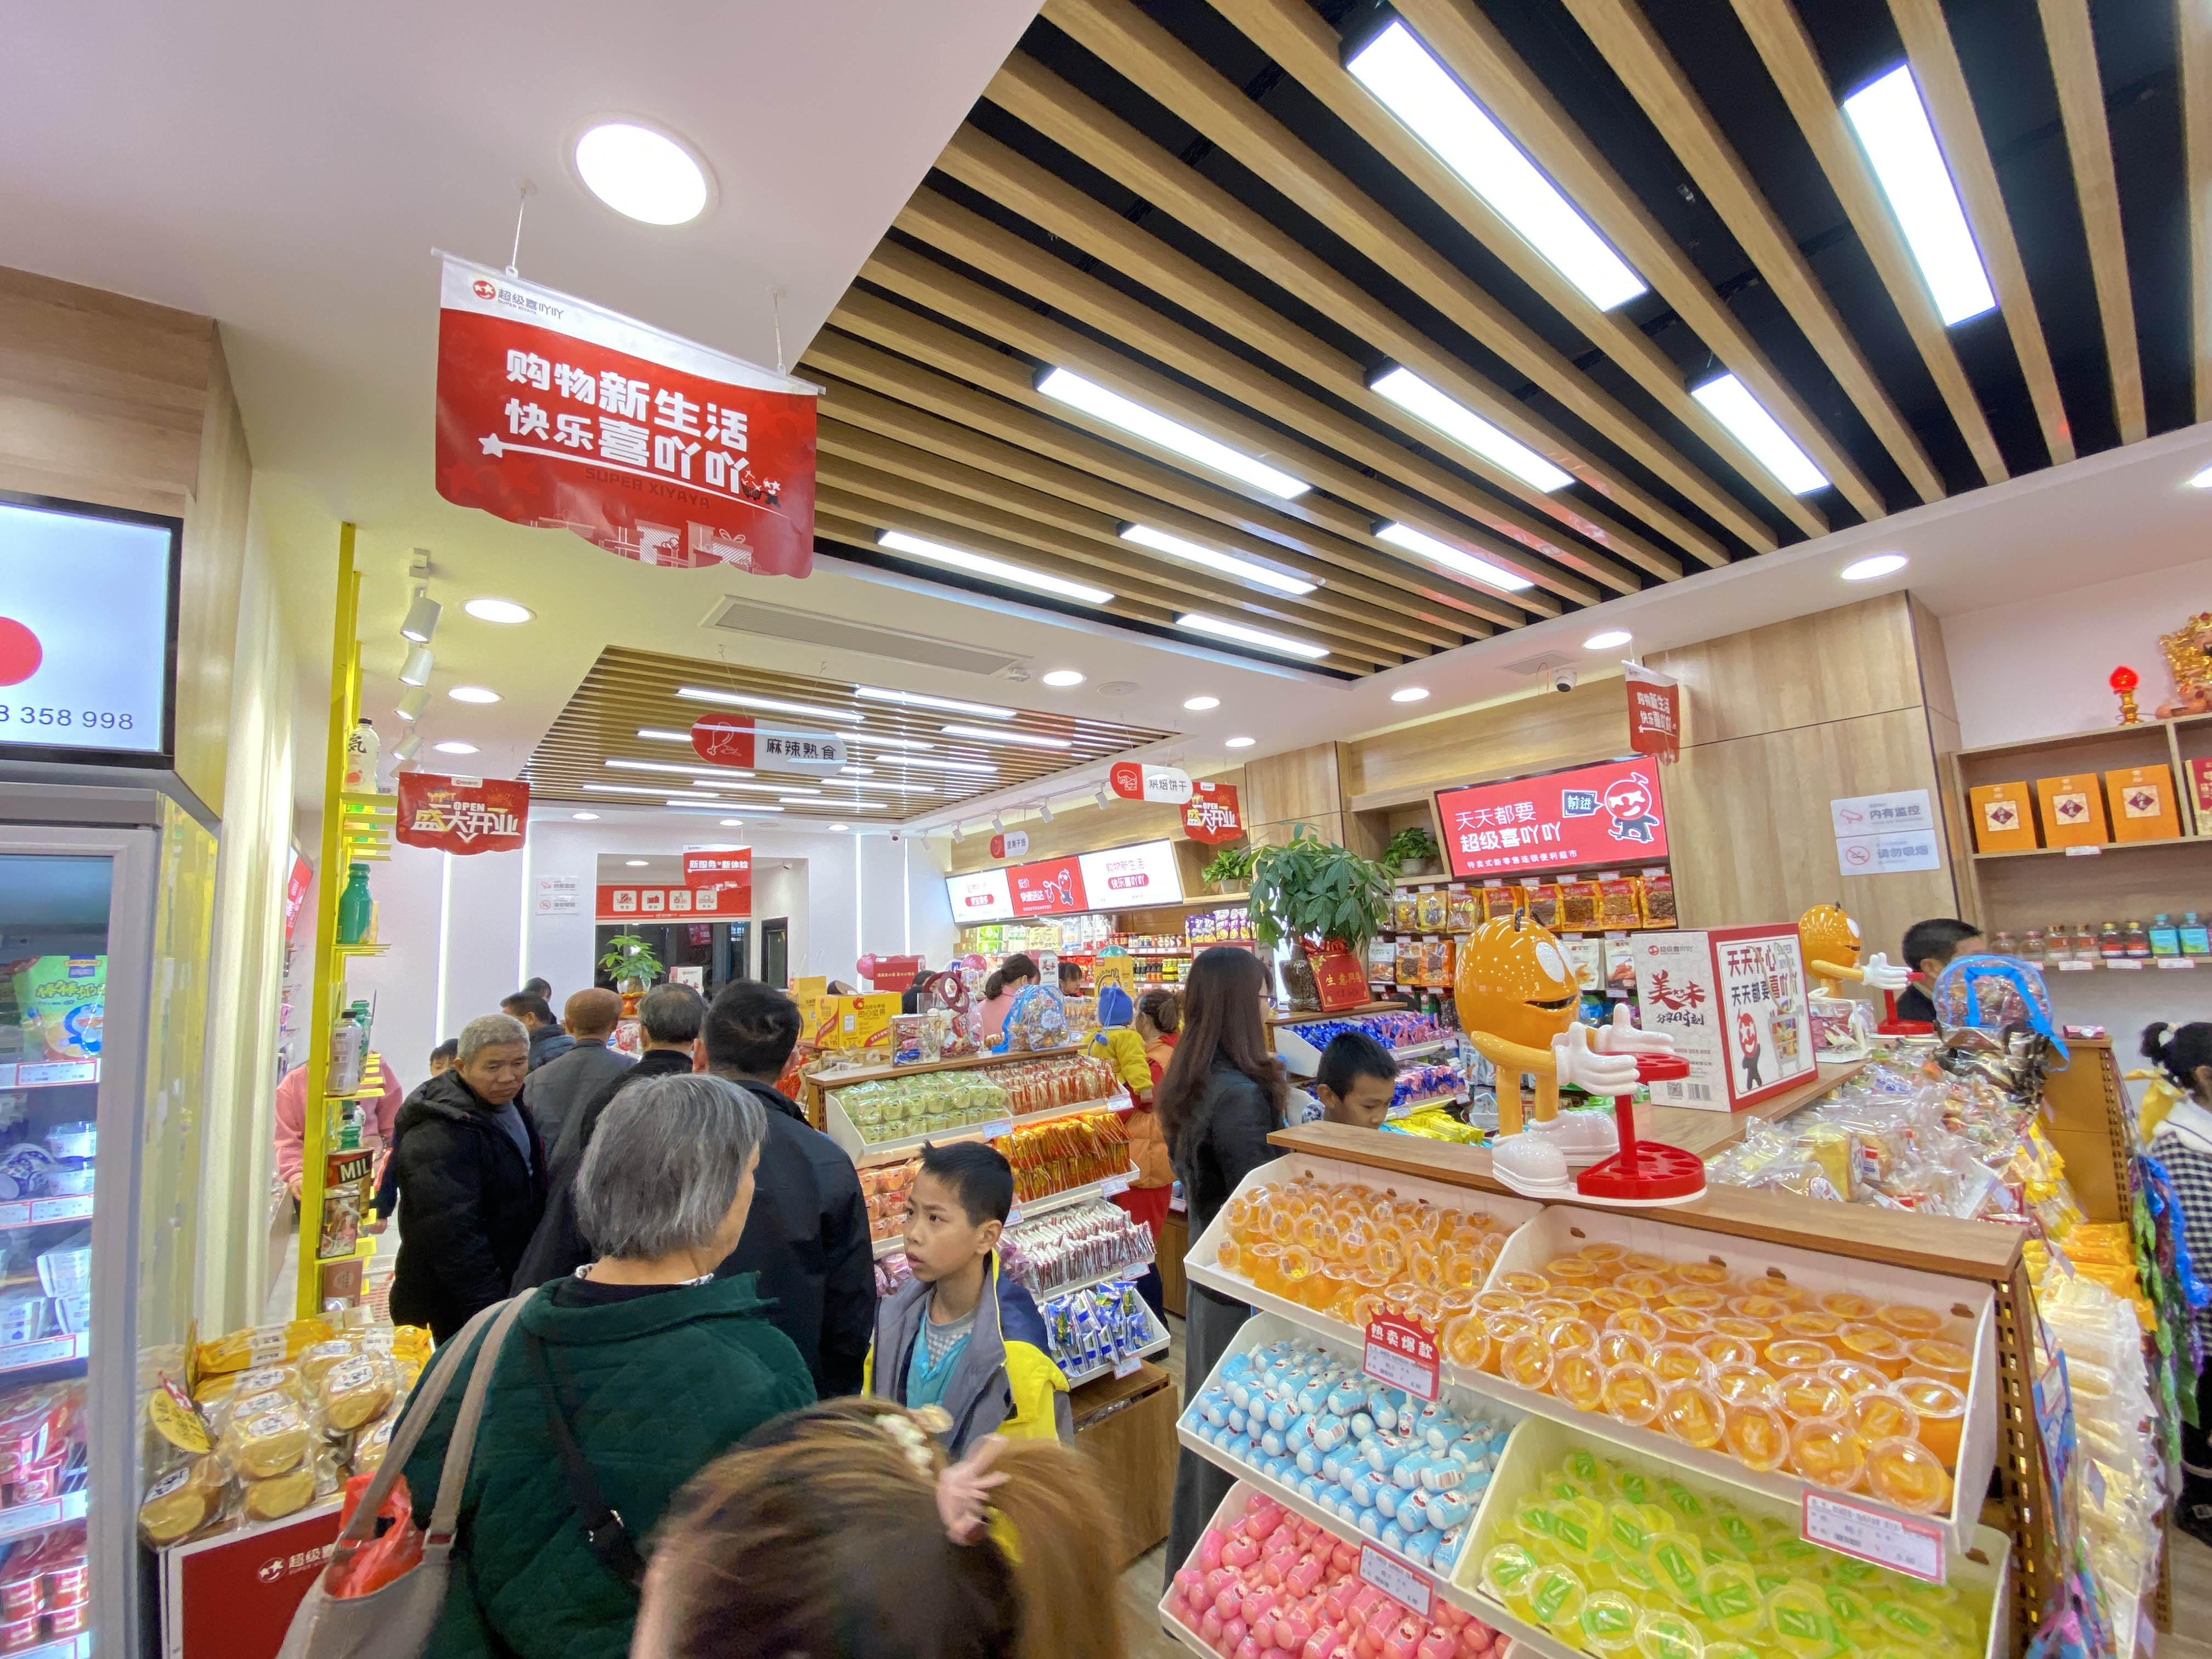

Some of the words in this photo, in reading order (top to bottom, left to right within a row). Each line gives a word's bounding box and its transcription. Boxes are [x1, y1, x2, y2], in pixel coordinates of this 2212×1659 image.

[498, 289, 564, 319] 超级喜吖吖
[506, 349, 748, 453] 购物新生活
[504, 398, 750, 494] 快乐喜吖吖
[584, 467, 643, 491] SUPER
[648, 481, 710, 509] XIYAYA
[20, 707, 72, 726] 358
[82, 711, 133, 730] 998
[766, 738, 837, 760] 麻辣熟食
[1149, 778, 1187, 793] 烘焙饼干
[453, 802, 485, 812] OPEN
[1567, 796, 1592, 810] 前进
[1870, 805, 1921, 820] 内有监控
[410, 806, 522, 839] 盛大开业
[1187, 808, 1238, 832] 盛大开业
[1455, 801, 1537, 831] 天天都要
[1459, 821, 1562, 854] 超级喜吖吖
[1466, 849, 1578, 870] 特卖式新零售连锁便利超市
[1877, 845, 1929, 859] 请勿吸烟
[1660, 945, 1694, 953] 超级喜吖吖
[1727, 945, 1776, 978] 天天开心
[1371, 1323, 1434, 1360] 热卖爆款
